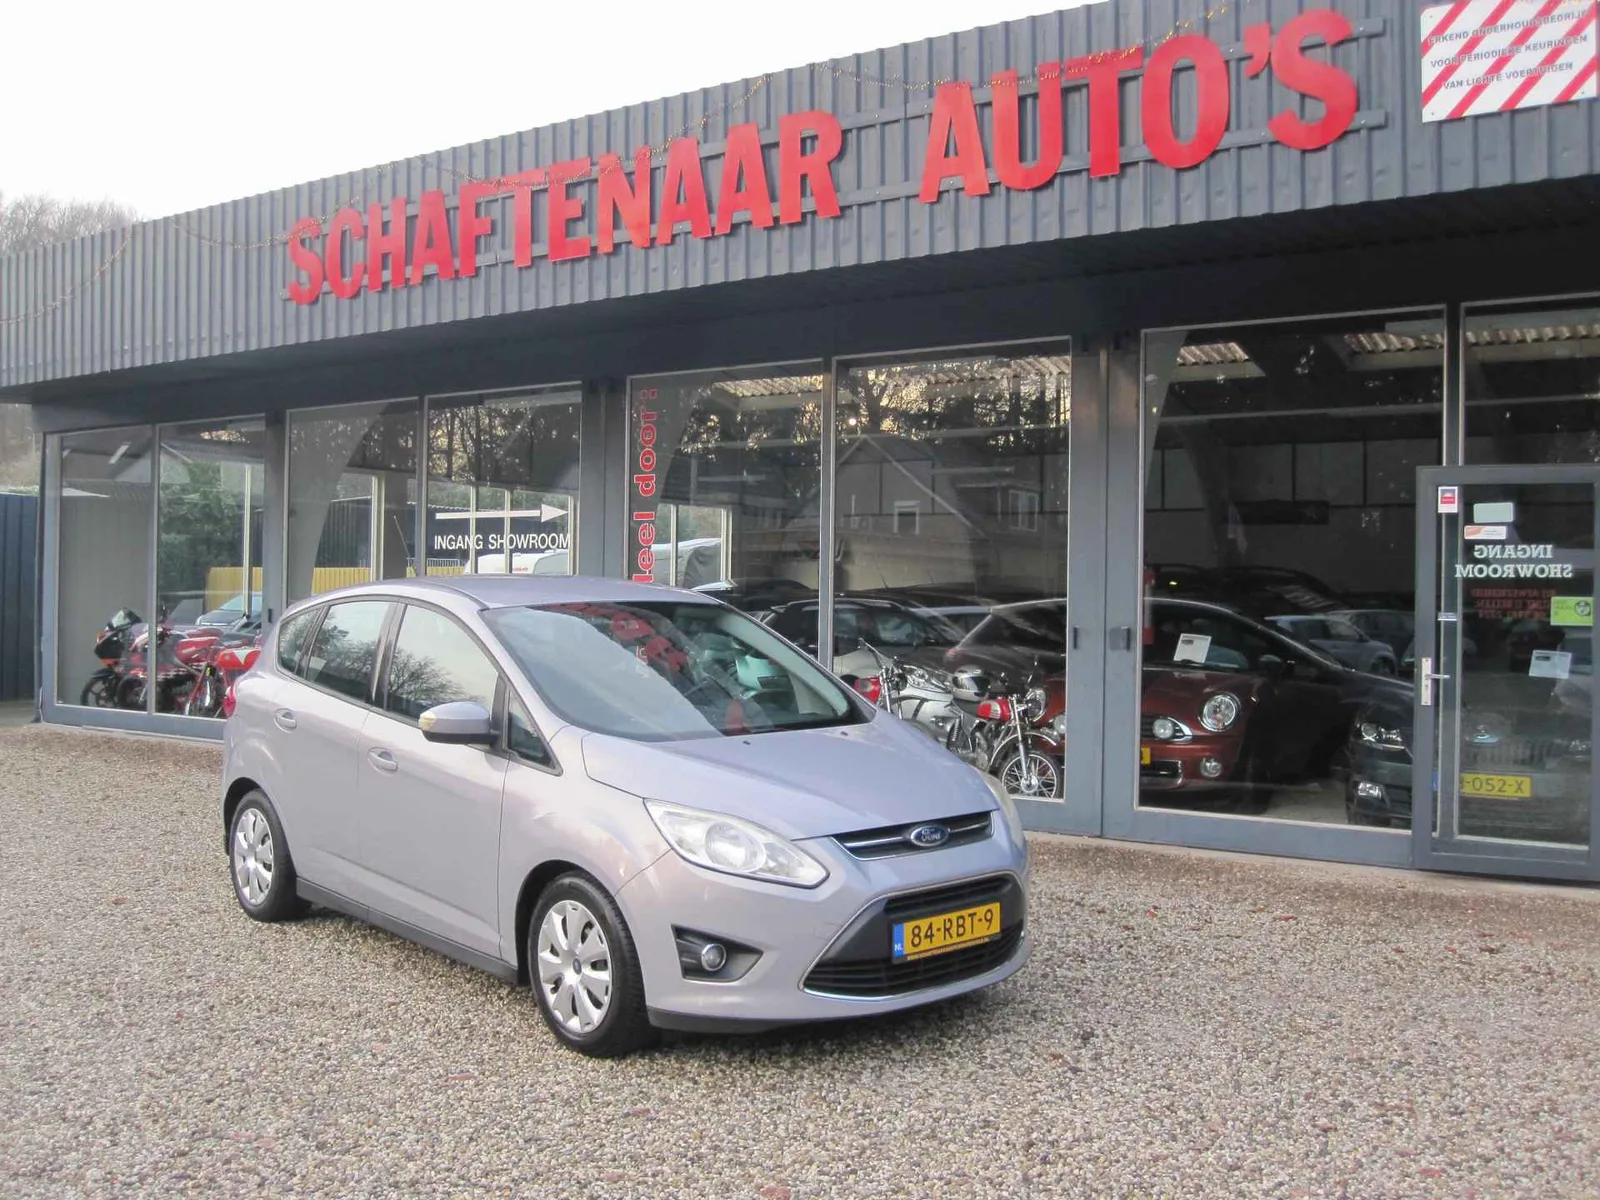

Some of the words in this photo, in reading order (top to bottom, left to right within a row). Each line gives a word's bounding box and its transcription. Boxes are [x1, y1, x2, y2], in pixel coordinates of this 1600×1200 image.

[1429, 31, 1469, 45] ERKEND
[1472, 9, 1587, 36] ONDERHOUDSBEDRIJF
[1430, 56, 1460, 68] VOOR
[1460, 46, 1522, 64] PERIODIEKE
[1525, 34, 1588, 52] KEURINGEN
[1444, 80, 1463, 90] VAN
[1466, 73, 1502, 87] LICHTE
[1506, 61, 1573, 80] VOERTUIGEN
[287, 109, 842, 305] SCHAFTENAAR
[919, 9, 1358, 203] AUTO'S
[434, 533, 483, 550] INGANG
[488, 533, 570, 549] SHOWROOM
[910, 908, 994, 948] 84-RBT-9
